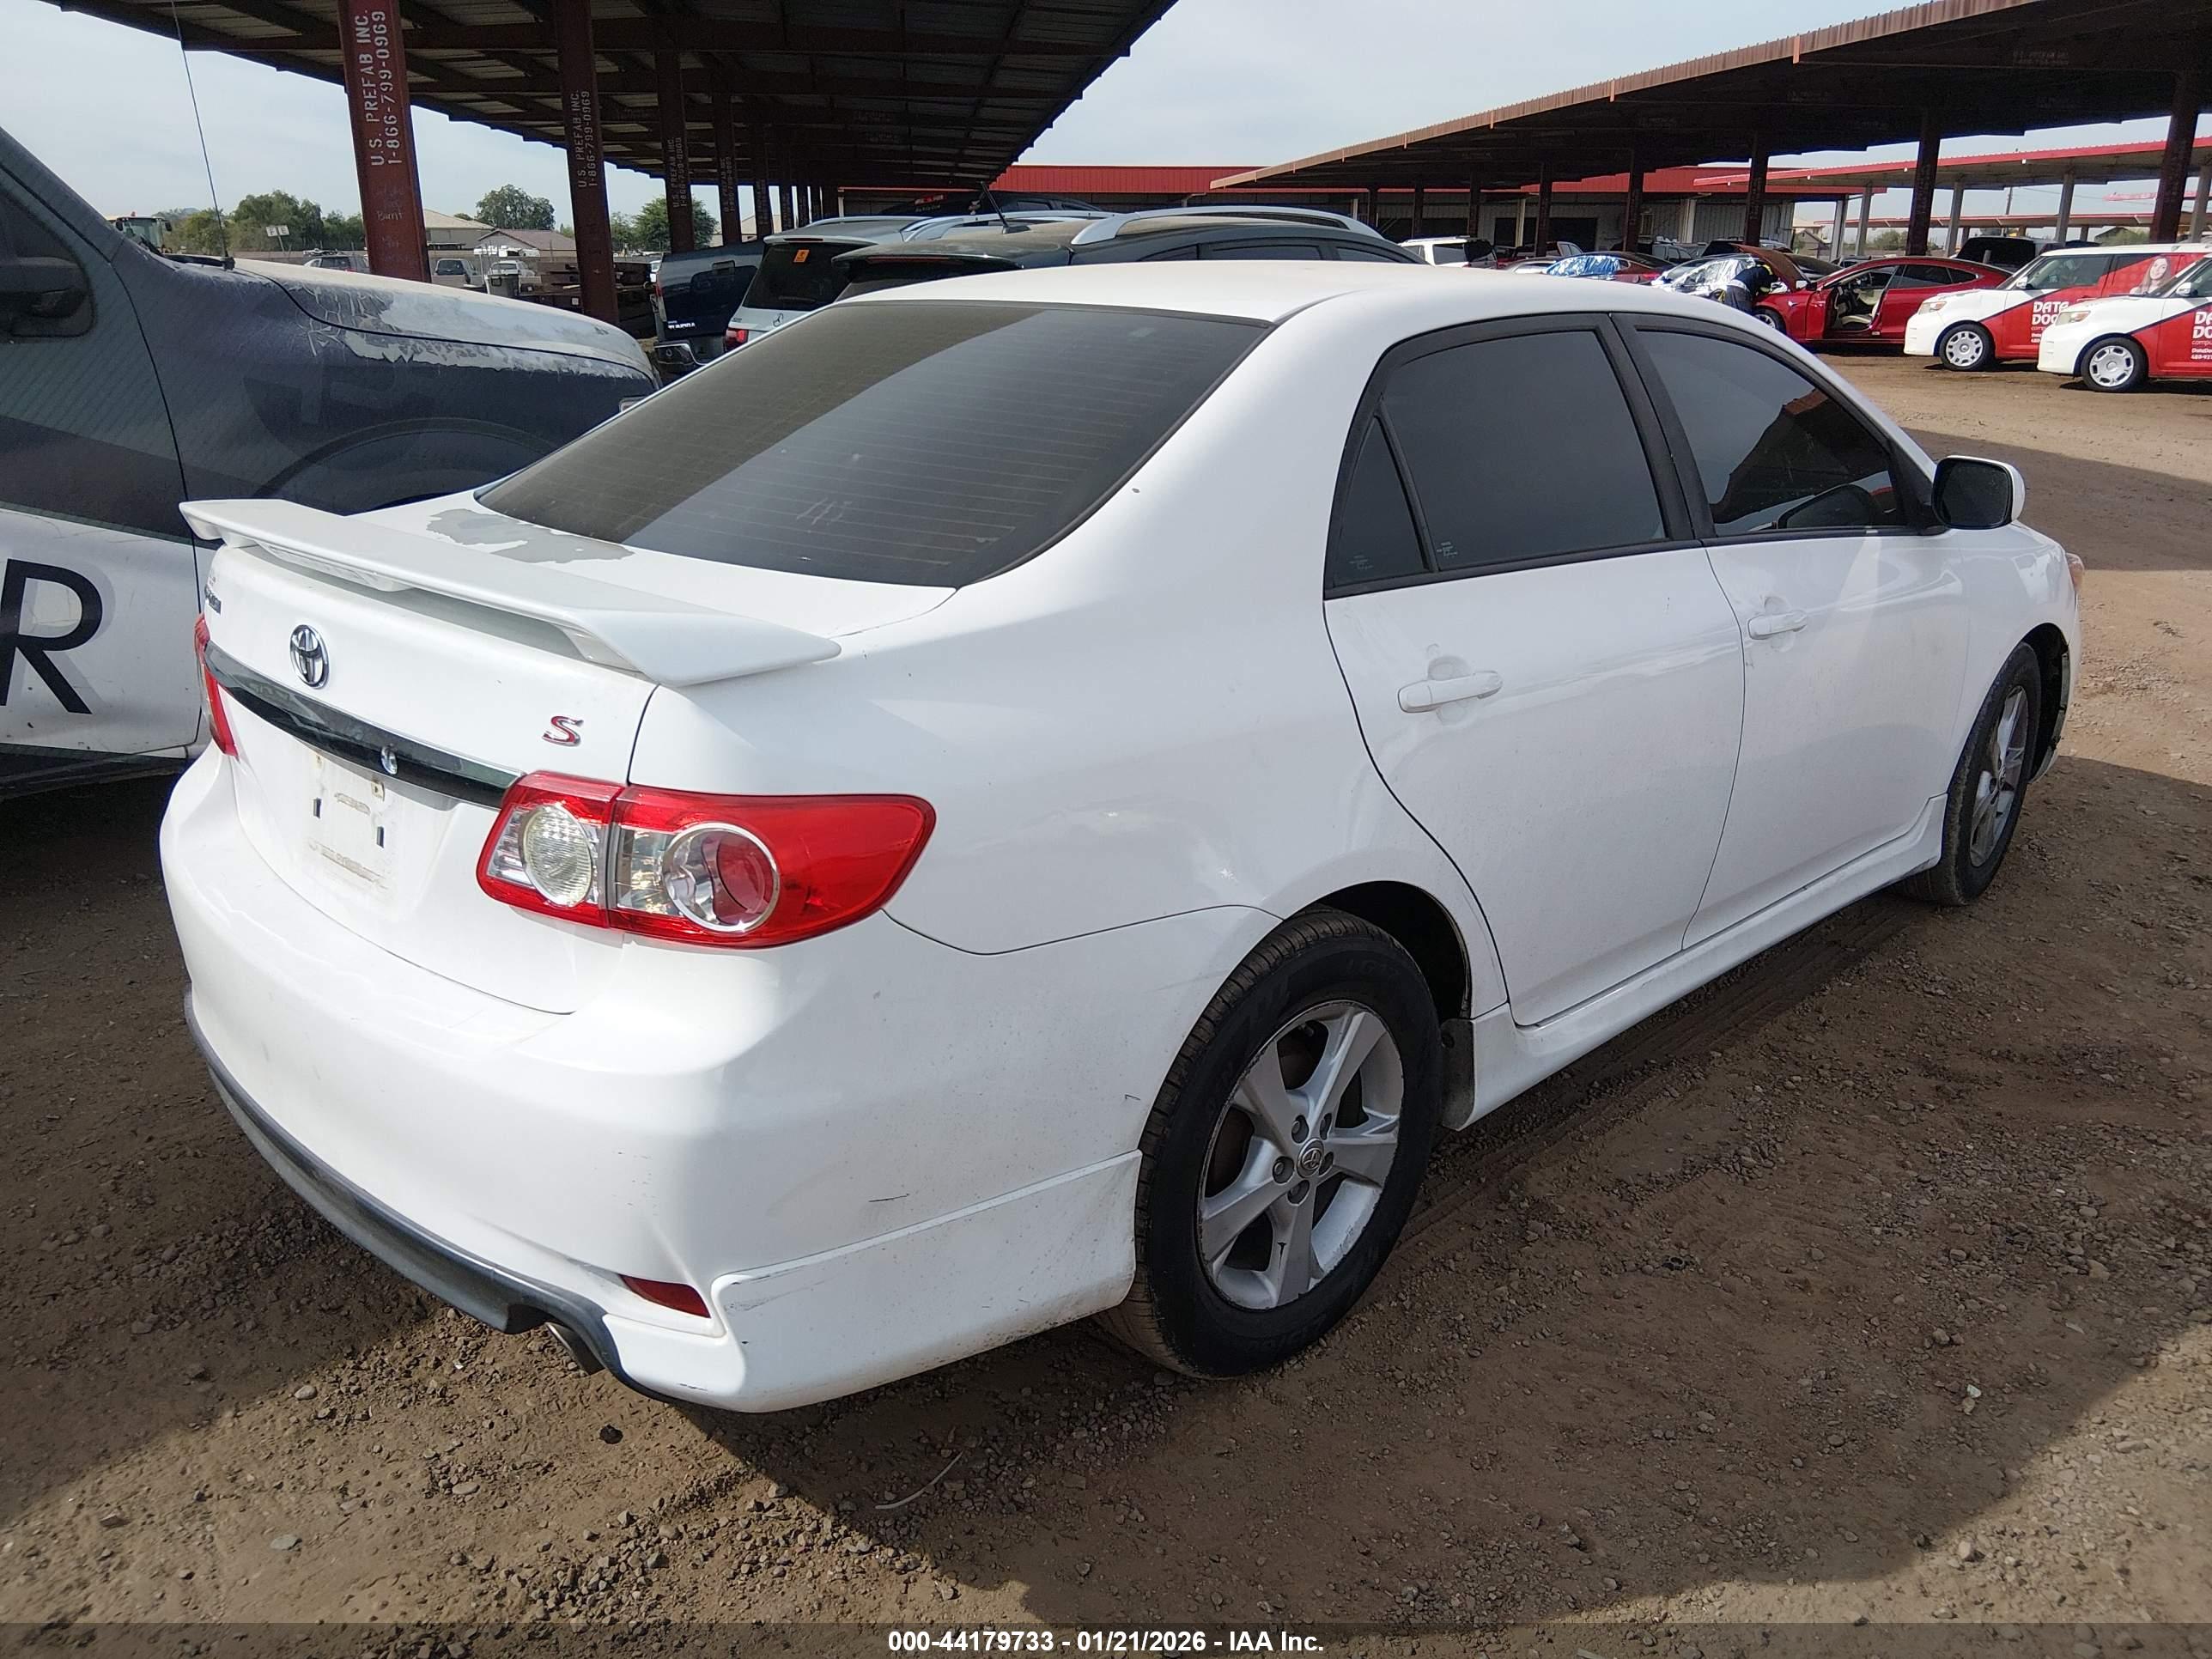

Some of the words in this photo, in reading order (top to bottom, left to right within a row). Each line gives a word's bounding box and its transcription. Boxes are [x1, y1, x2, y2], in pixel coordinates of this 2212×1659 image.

[355, 9, 372, 44] INC.
[359, 53, 380, 122] PREFAB
[371, 11, 402, 165] 1-866-799-0969
[570, 89, 580, 112] INC.
[369, 133, 385, 166] U.S.
[572, 117, 585, 161] PREFAB
[580, 91, 598, 186] 1-866-799-0969
[577, 166, 587, 188] U.S.
[0, 558, 103, 714] R
[542, 715, 585, 747] S
